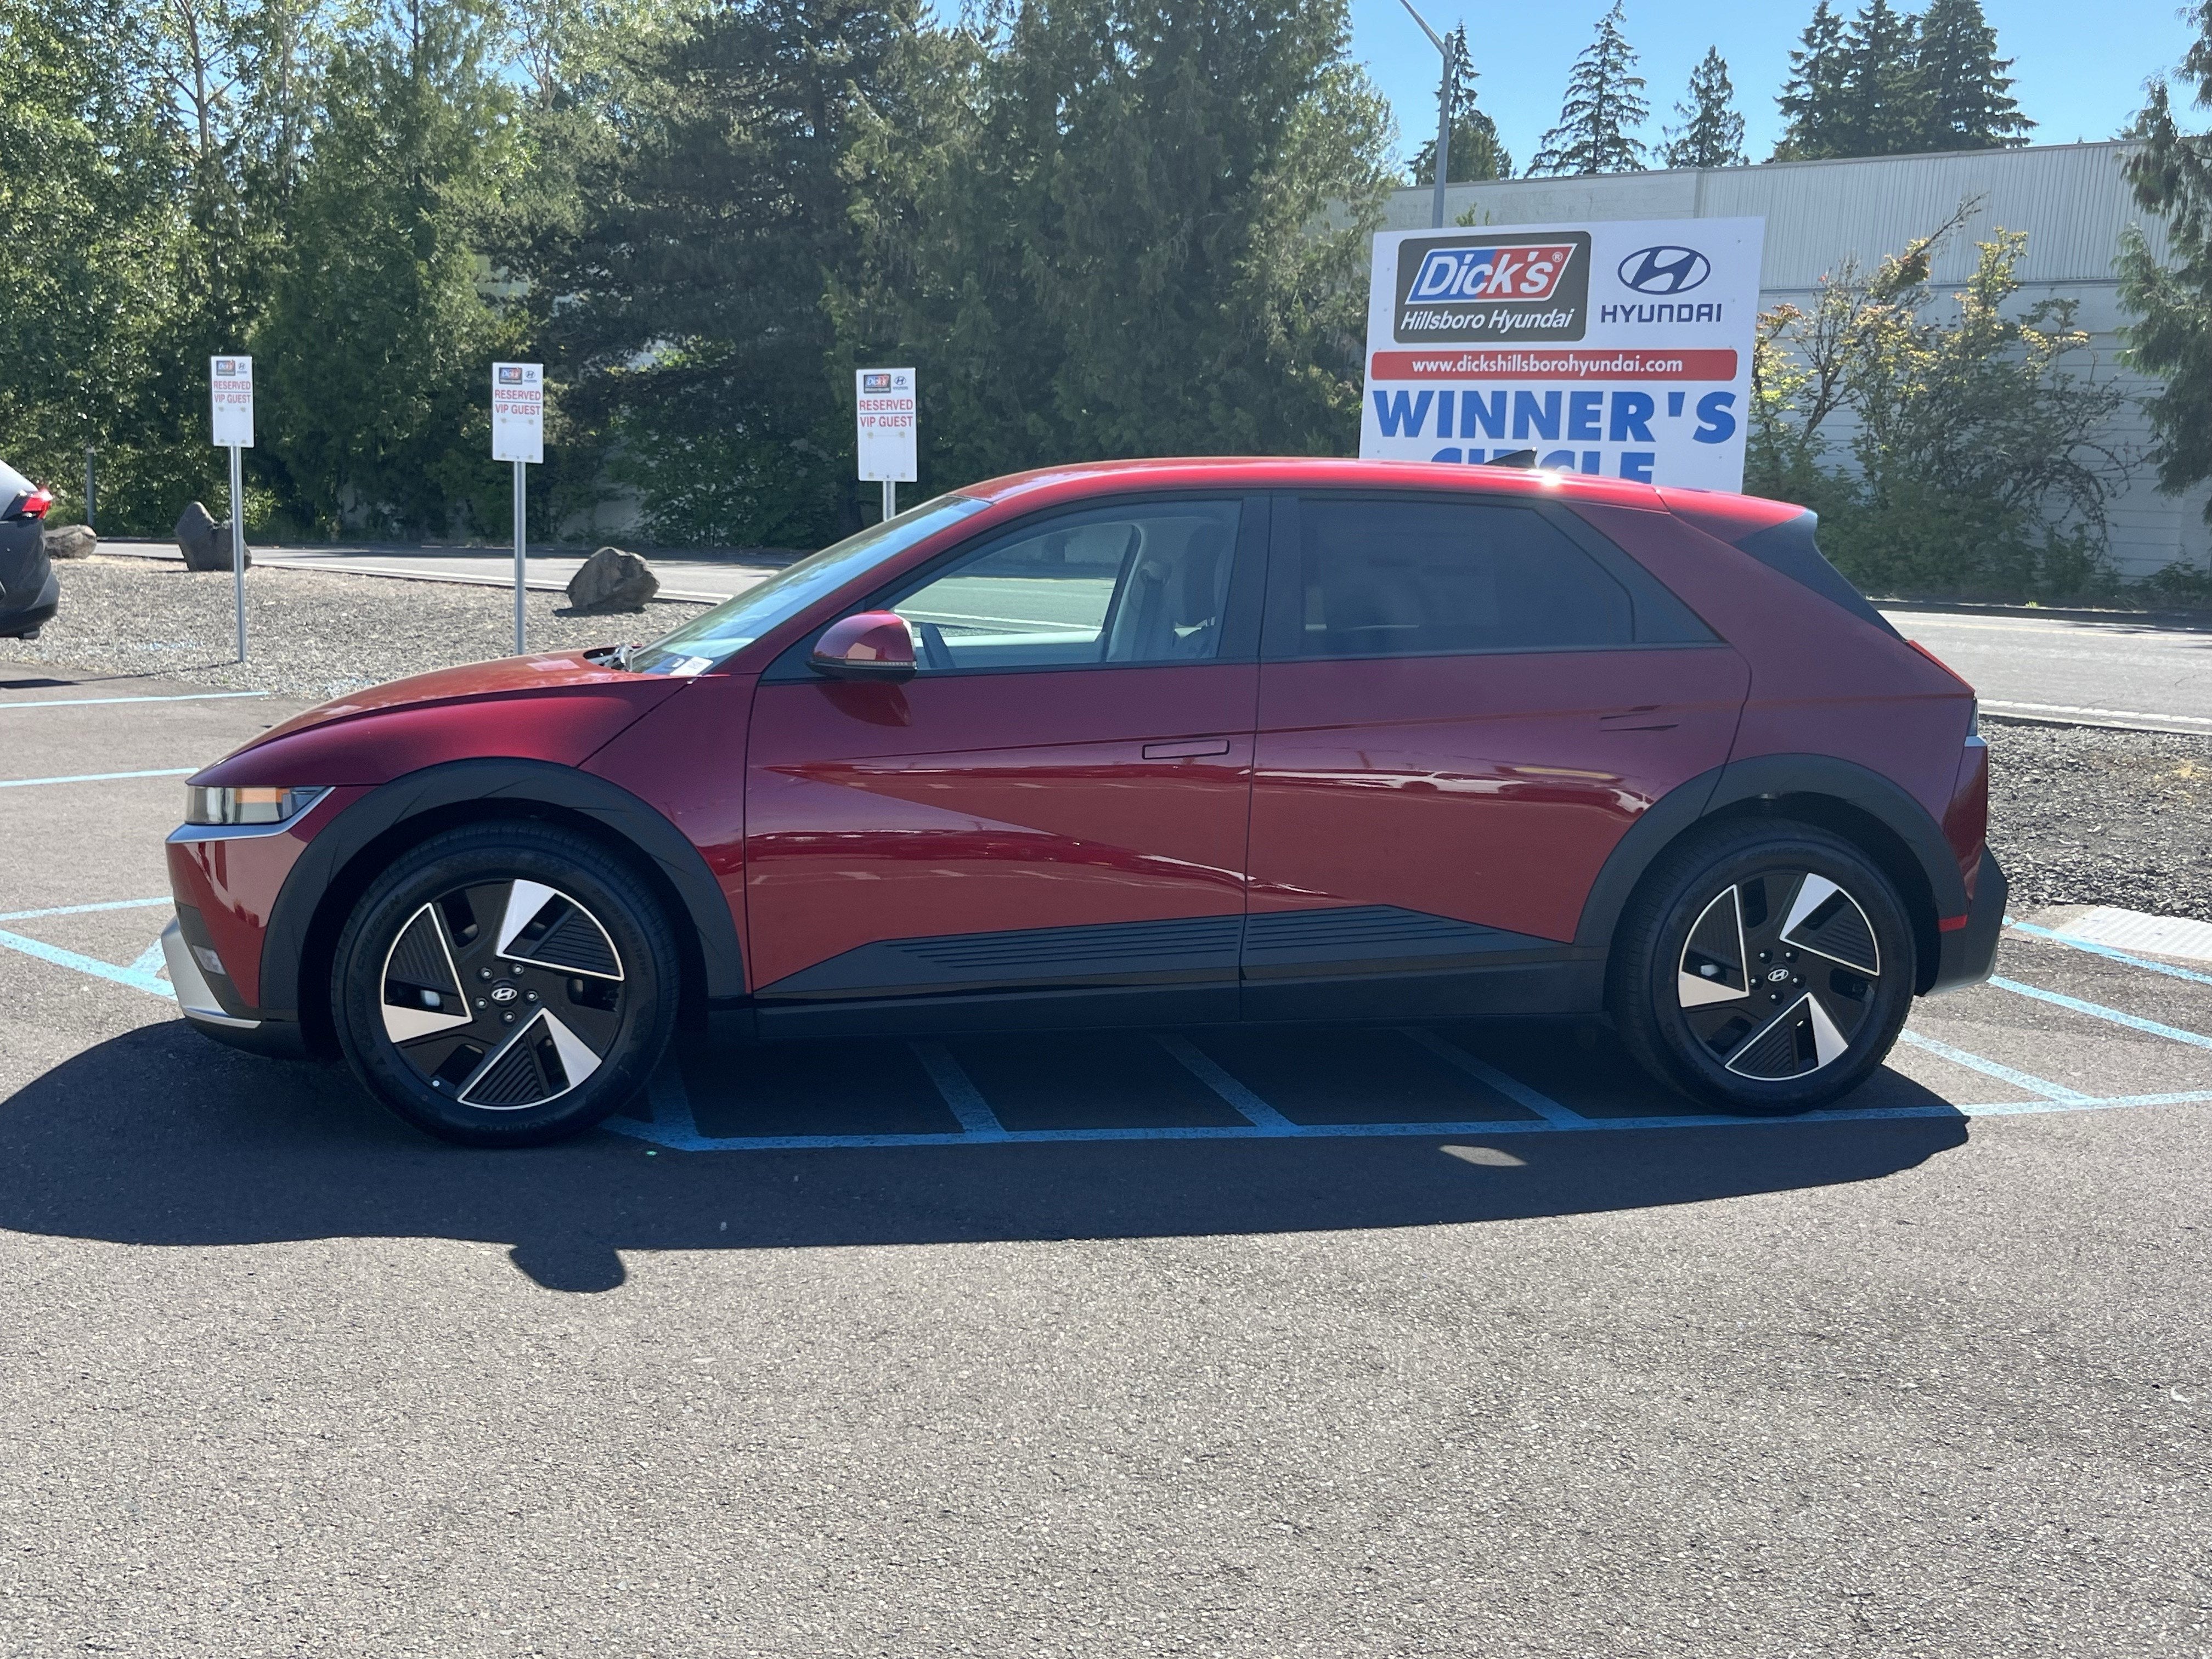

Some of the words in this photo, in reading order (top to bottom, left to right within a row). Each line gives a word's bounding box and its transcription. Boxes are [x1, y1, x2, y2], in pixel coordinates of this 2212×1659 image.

[1601, 303, 1722, 323] HYUNDAI
[1400, 310, 1486, 330] Hillsboro
[1488, 308, 1575, 334] Hyundai
[1412, 354, 1683, 376] www.dickshillsborohyundai.com
[213, 381, 251, 390] RESERVED
[214, 394, 225, 403] VIP
[227, 394, 251, 404] GUEST
[495, 390, 541, 400] RESERVED
[495, 404, 509, 413] VIP
[511, 404, 540, 415] GUEST
[859, 399, 913, 411] RESERVED
[860, 416, 876, 427] VIP
[879, 416, 913, 427] GUEST
[1372, 391, 1736, 444] WINNER'S
